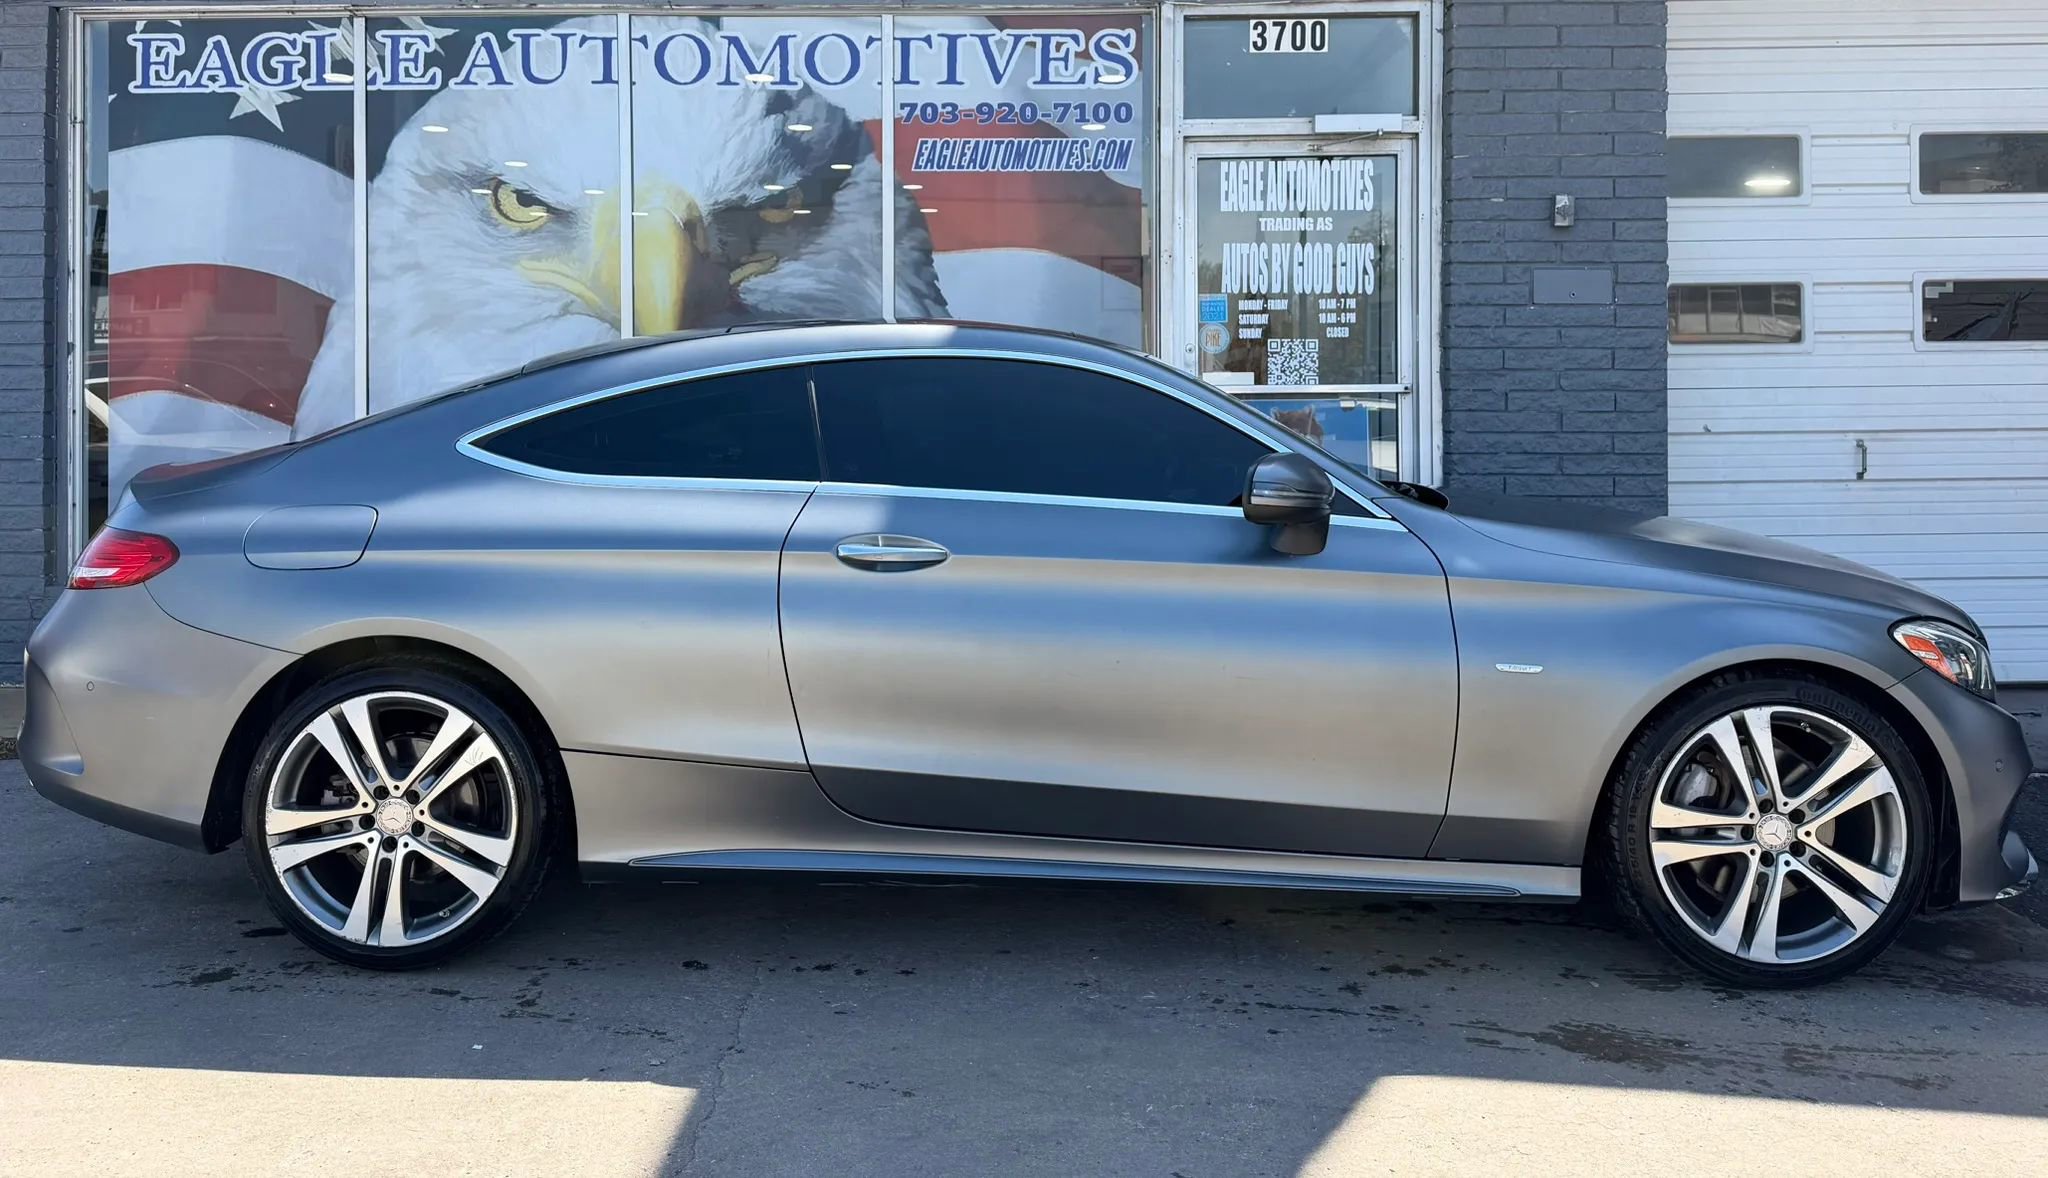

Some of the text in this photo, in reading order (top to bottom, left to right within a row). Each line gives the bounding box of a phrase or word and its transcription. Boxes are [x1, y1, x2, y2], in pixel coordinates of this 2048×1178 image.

[1251, 20, 1328, 52] 3700
[129, 29, 1136, 92] EAGLE AUTOMOTIVES
[900, 101, 1134, 125] 703-920-7100
[912, 137, 1134, 172] EAGLEAUTOMOTIVES.COM
[1220, 159, 1374, 212] EAGLE AUTOMOTIVES
[1259, 217, 1333, 231] TRADING AS
[1221, 242, 1375, 295] AUTOS BY GOOD GUYS
[1238, 299, 1263, 310] MONDAY
[1267, 299, 1288, 310] FRIDAY
[1326, 298, 1337, 309] AM
[1340, 298, 1345, 309] 7
[1346, 298, 1356, 309] PM
[1238, 313, 1269, 325] SATURDAY
[1326, 312, 1337, 323] AM
[1346, 312, 1356, 323] PM
[1238, 327, 1349, 339] SUNDAY CLOSED
